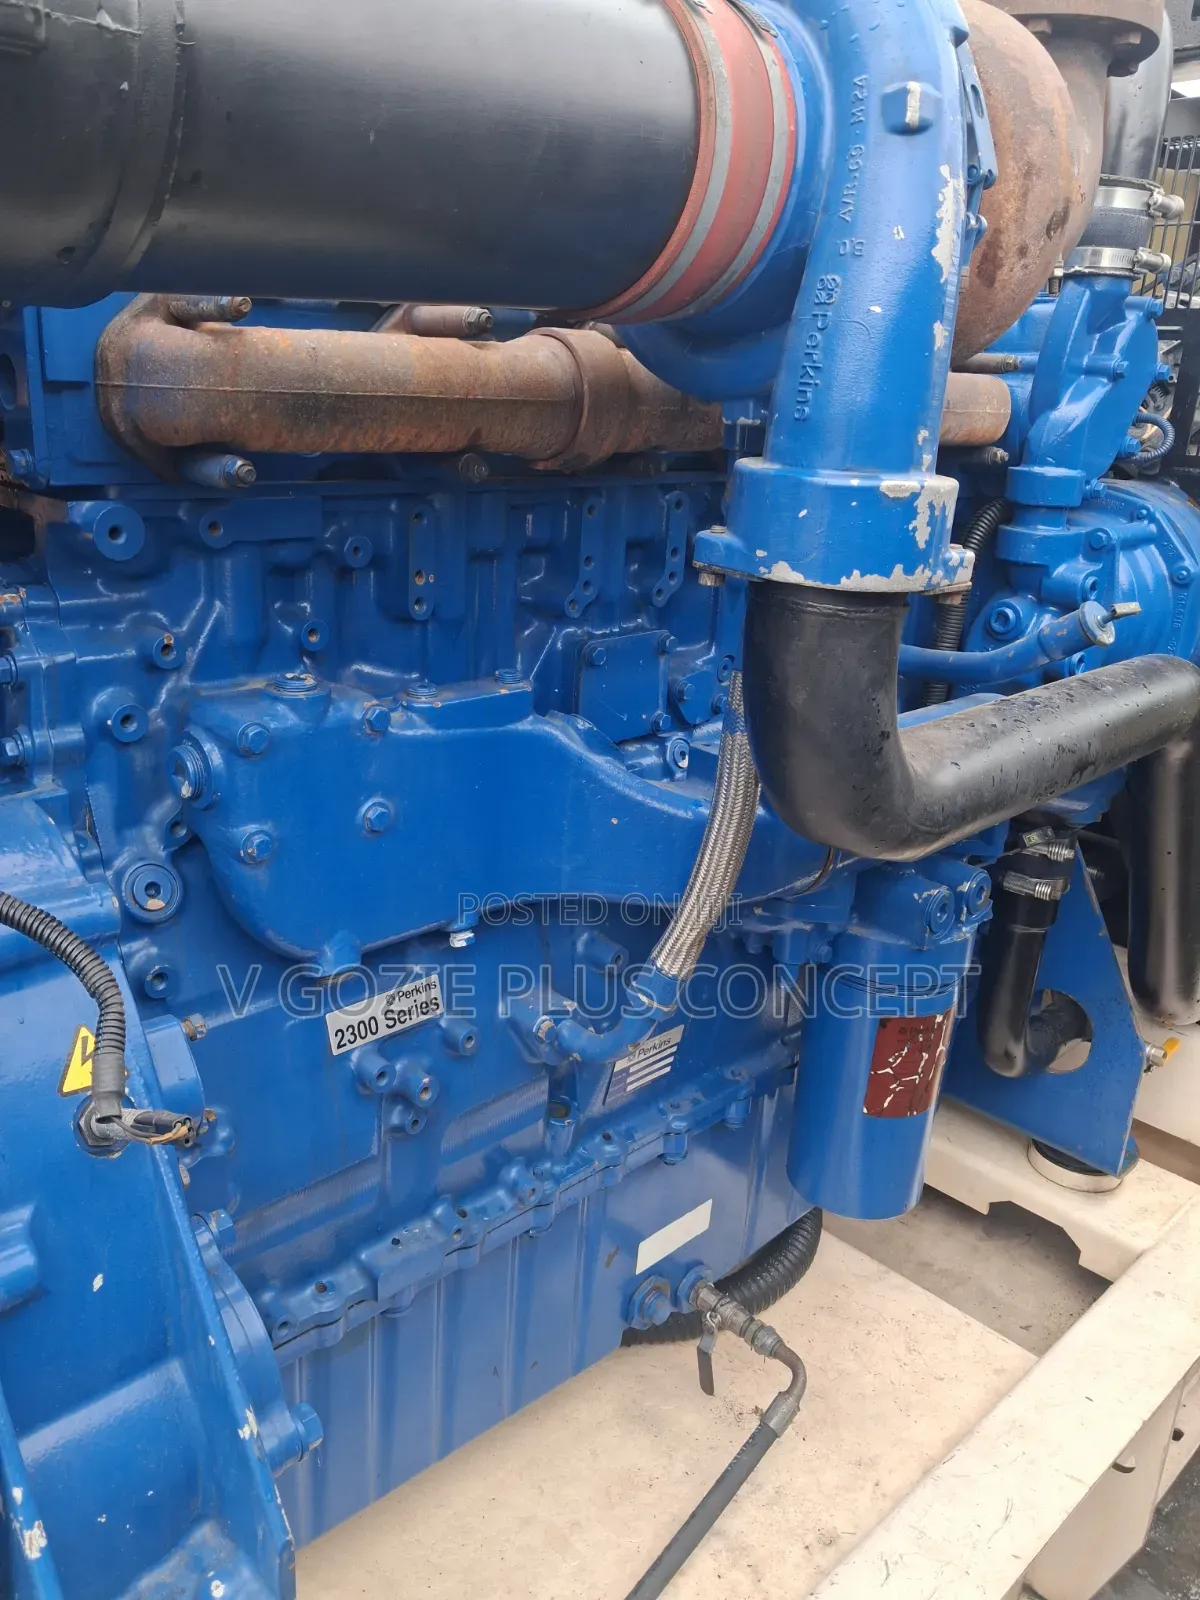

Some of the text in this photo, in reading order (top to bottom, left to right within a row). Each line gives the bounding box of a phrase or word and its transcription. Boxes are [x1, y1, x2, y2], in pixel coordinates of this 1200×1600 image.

[794, 311, 833, 421] Perkins
[397, 980, 437, 1003] Perkins
[334, 996, 440, 1050] 2300 Series
[637, 1037, 672, 1058] Perkins
